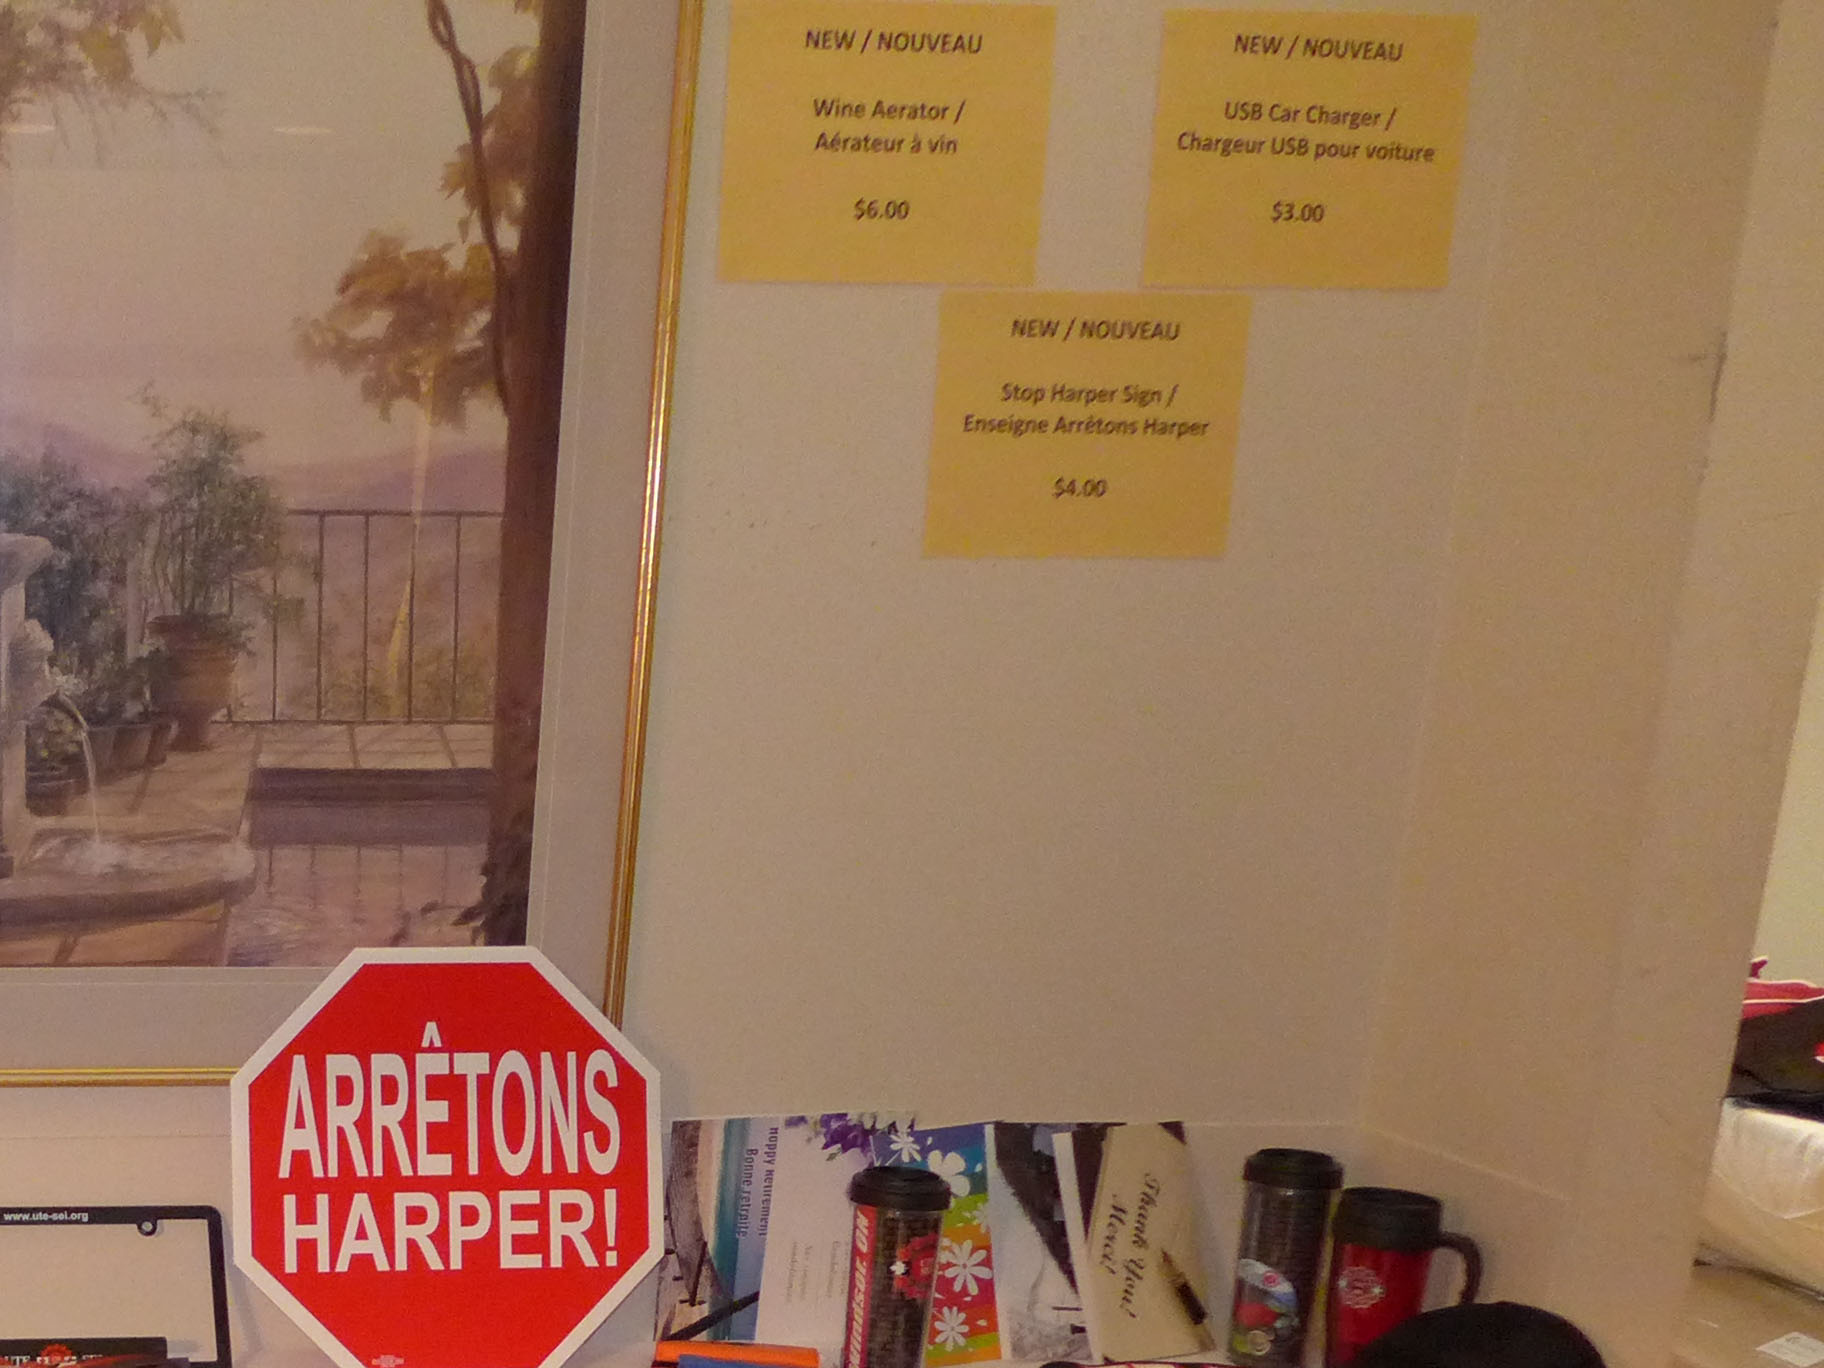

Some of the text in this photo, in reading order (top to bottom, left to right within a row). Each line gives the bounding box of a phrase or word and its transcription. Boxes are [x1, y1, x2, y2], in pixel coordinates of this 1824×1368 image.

[805, 29, 982, 54] NEW / NOUVEAU
[1234, 34, 1403, 62] NEW / NOUVEAU
[813, 98, 966, 124] Wine Aerator /
[1225, 101, 1397, 131] USB Car Charger /
[814, 132, 905, 153] Aérateur
[928, 135, 958, 154] vin
[1177, 131, 1435, 162] Chargeur USB pour voiture
[854, 197, 910, 220] $6.00
[1271, 200, 1324, 223] $3.00
[1011, 317, 1180, 341] NEW / NOUVEAU
[1001, 383, 1045, 405] Stop
[1051, 383, 1118, 406] Harper
[1123, 385, 1162, 407] Sign
[963, 414, 1048, 437] Enseigne
[1143, 418, 1210, 439] Harper
[1052, 476, 1107, 499] $4.00
[279, 1021, 620, 1179] ARRÊTONS
[737, 1148, 758, 1239] Bonne retraite
[1132, 1173, 1160, 1250] Thank
[284, 1187, 618, 1275] HARPER!
